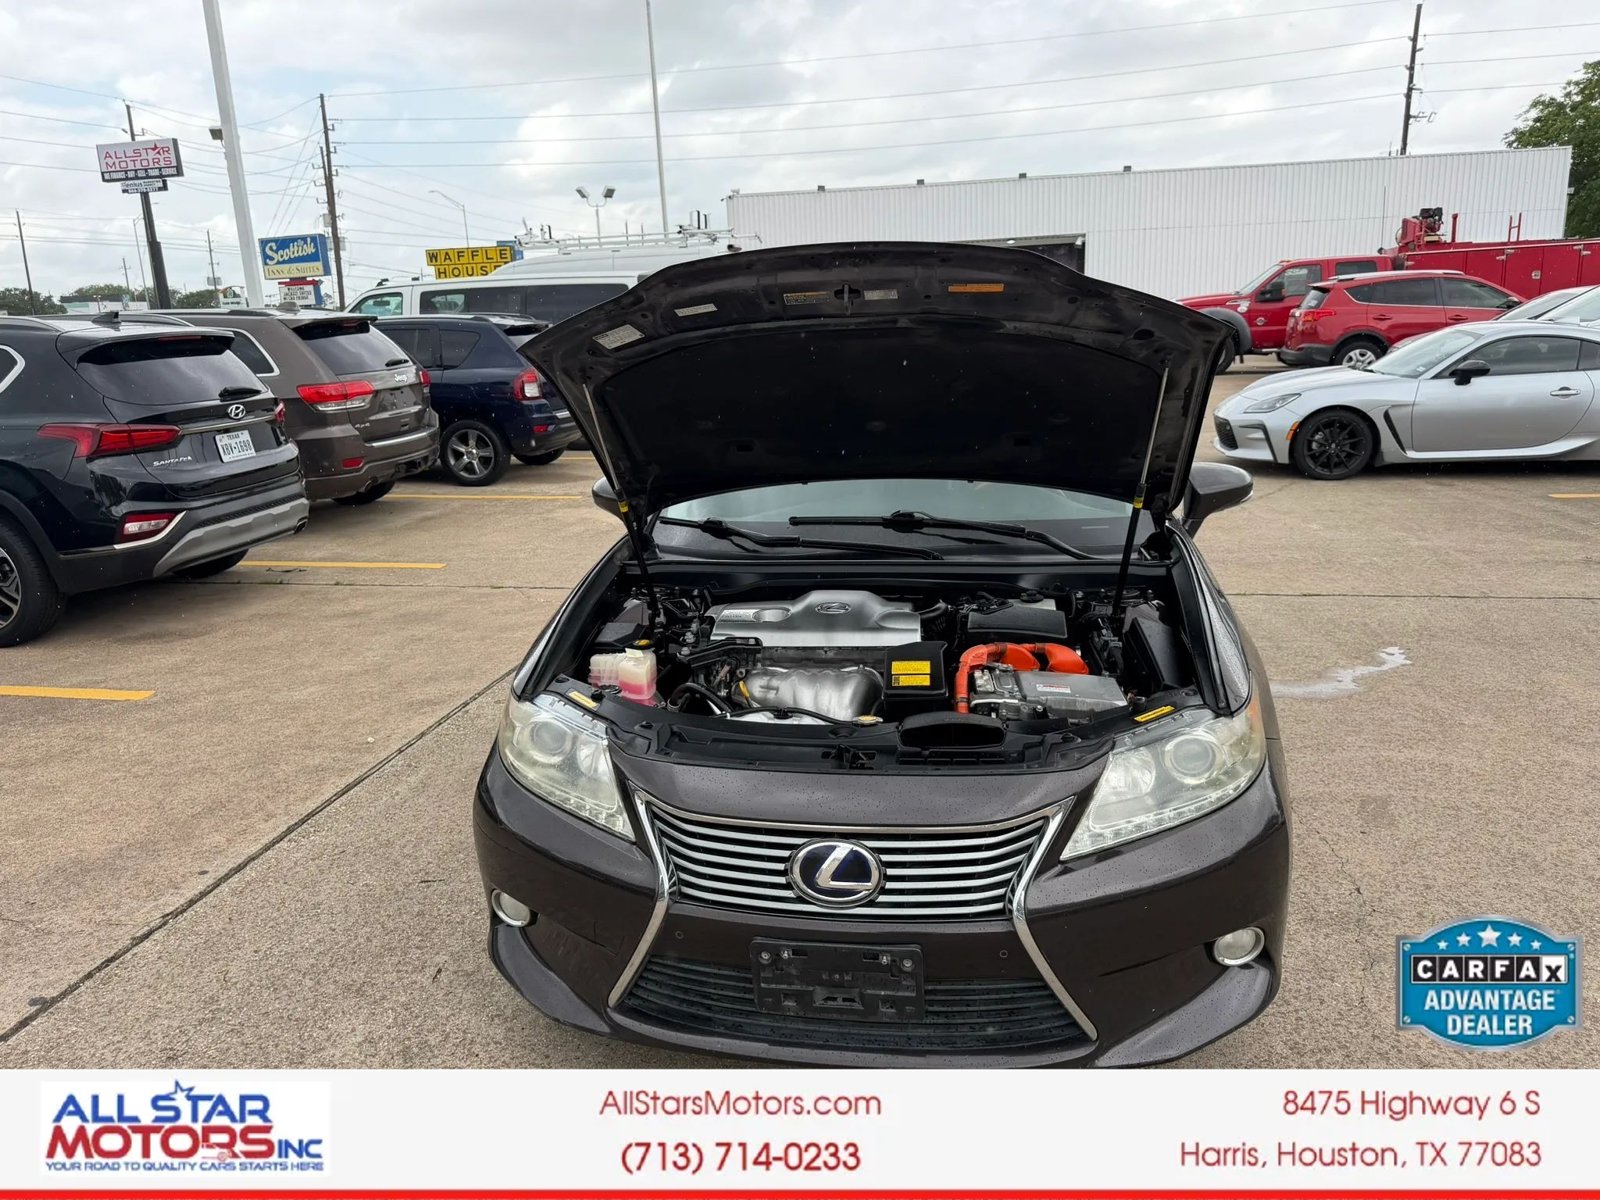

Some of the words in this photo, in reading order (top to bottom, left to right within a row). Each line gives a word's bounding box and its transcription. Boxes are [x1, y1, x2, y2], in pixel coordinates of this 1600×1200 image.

[105, 156, 172, 170] MOTORS
[265, 237, 316, 265] Scottish
[428, 248, 508, 263] WAFFLE
